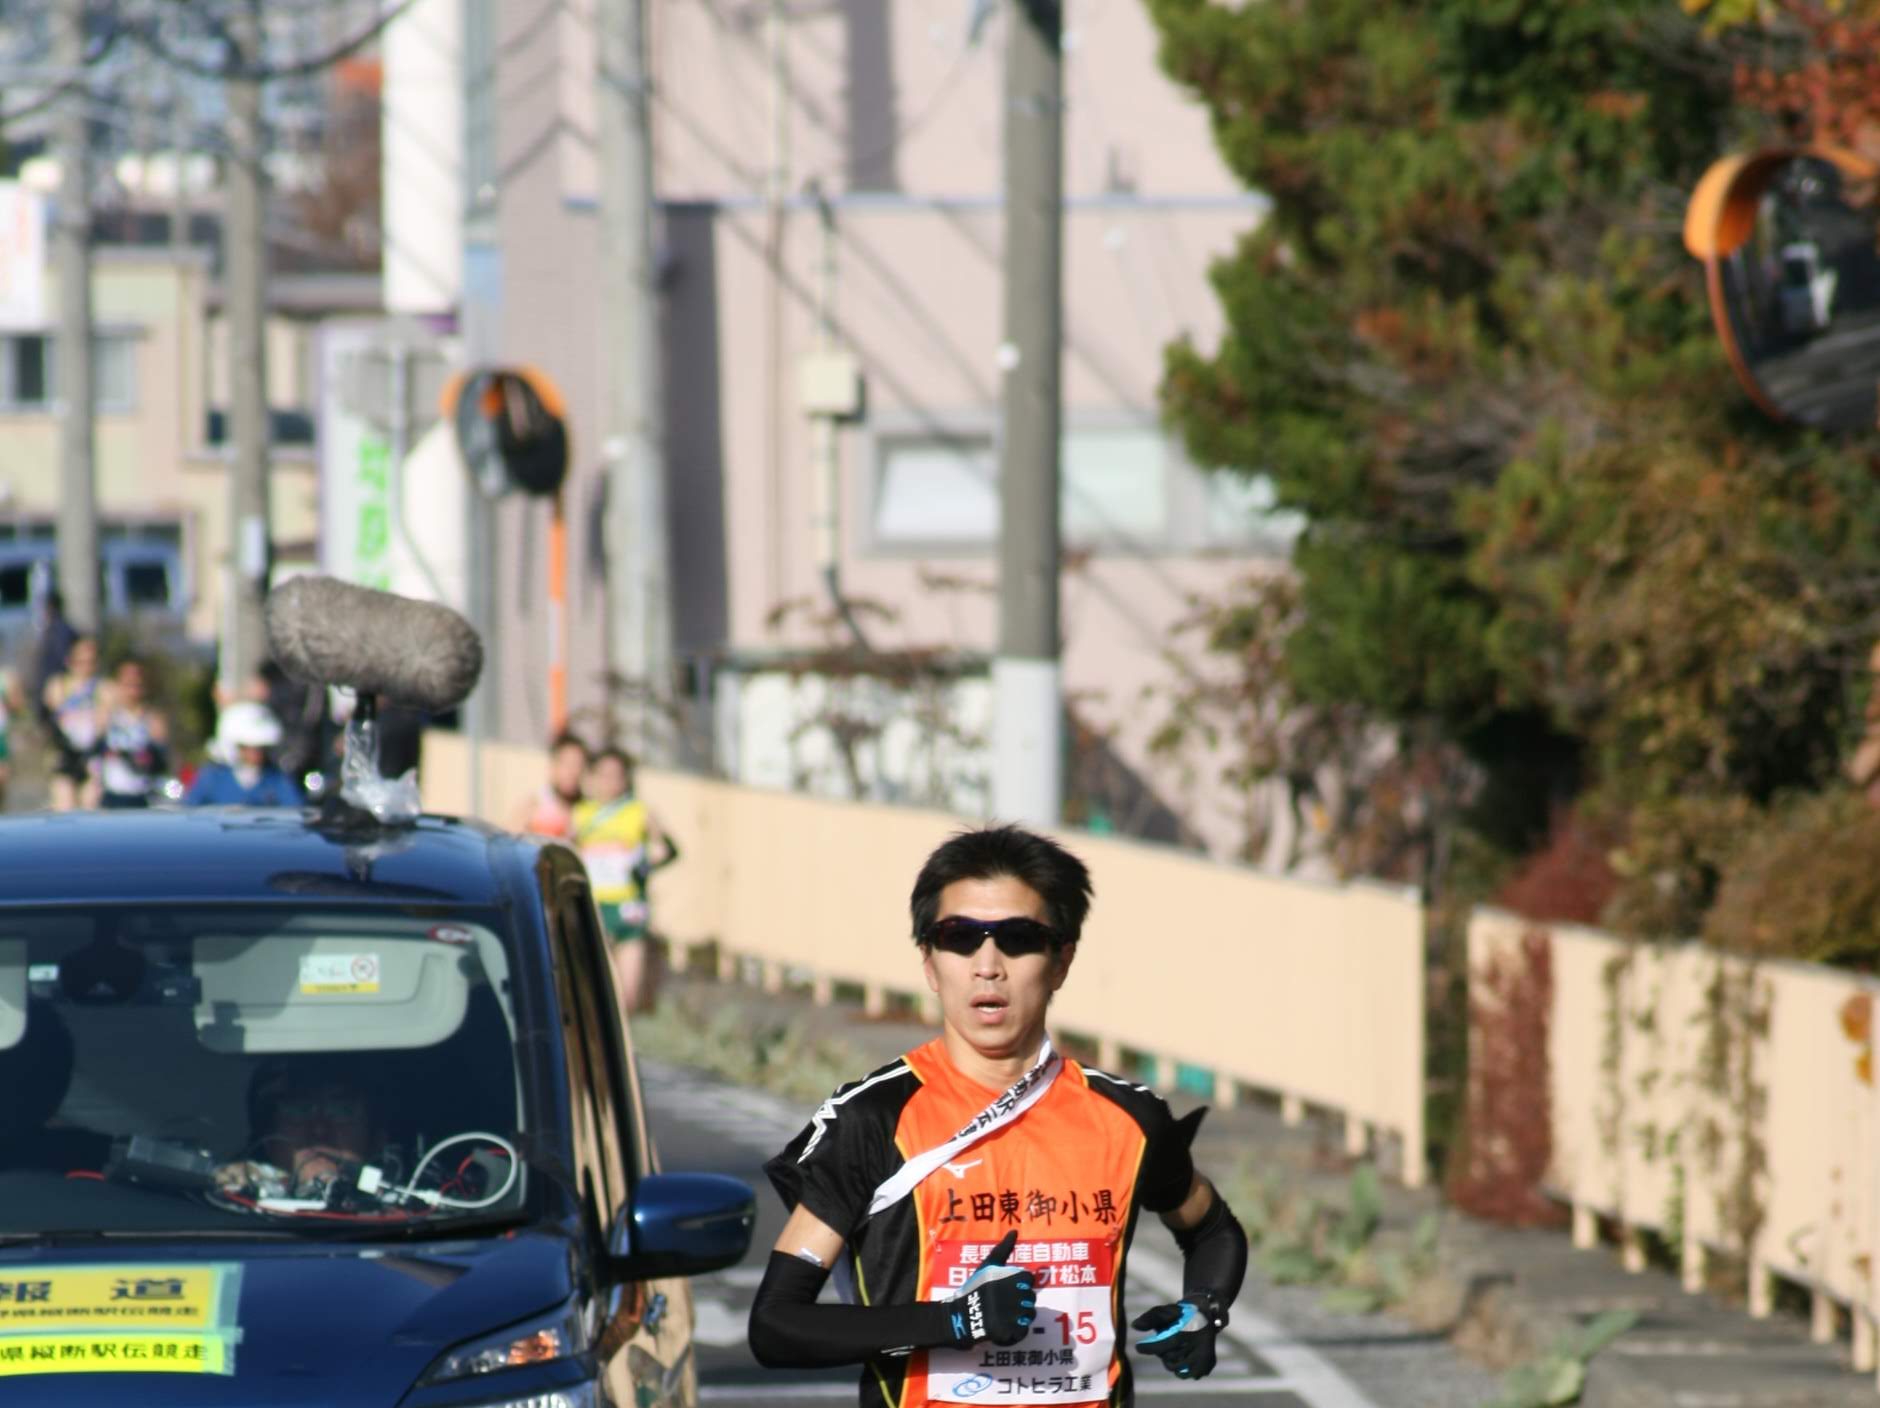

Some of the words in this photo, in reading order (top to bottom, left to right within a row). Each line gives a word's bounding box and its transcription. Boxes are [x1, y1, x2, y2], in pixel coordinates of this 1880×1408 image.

[939, 1188, 1118, 1226] 上田東御小県
[979, 1348, 1075, 1368] 上田東御小県
[997, 1375, 1093, 1395] コトヒラ工業
